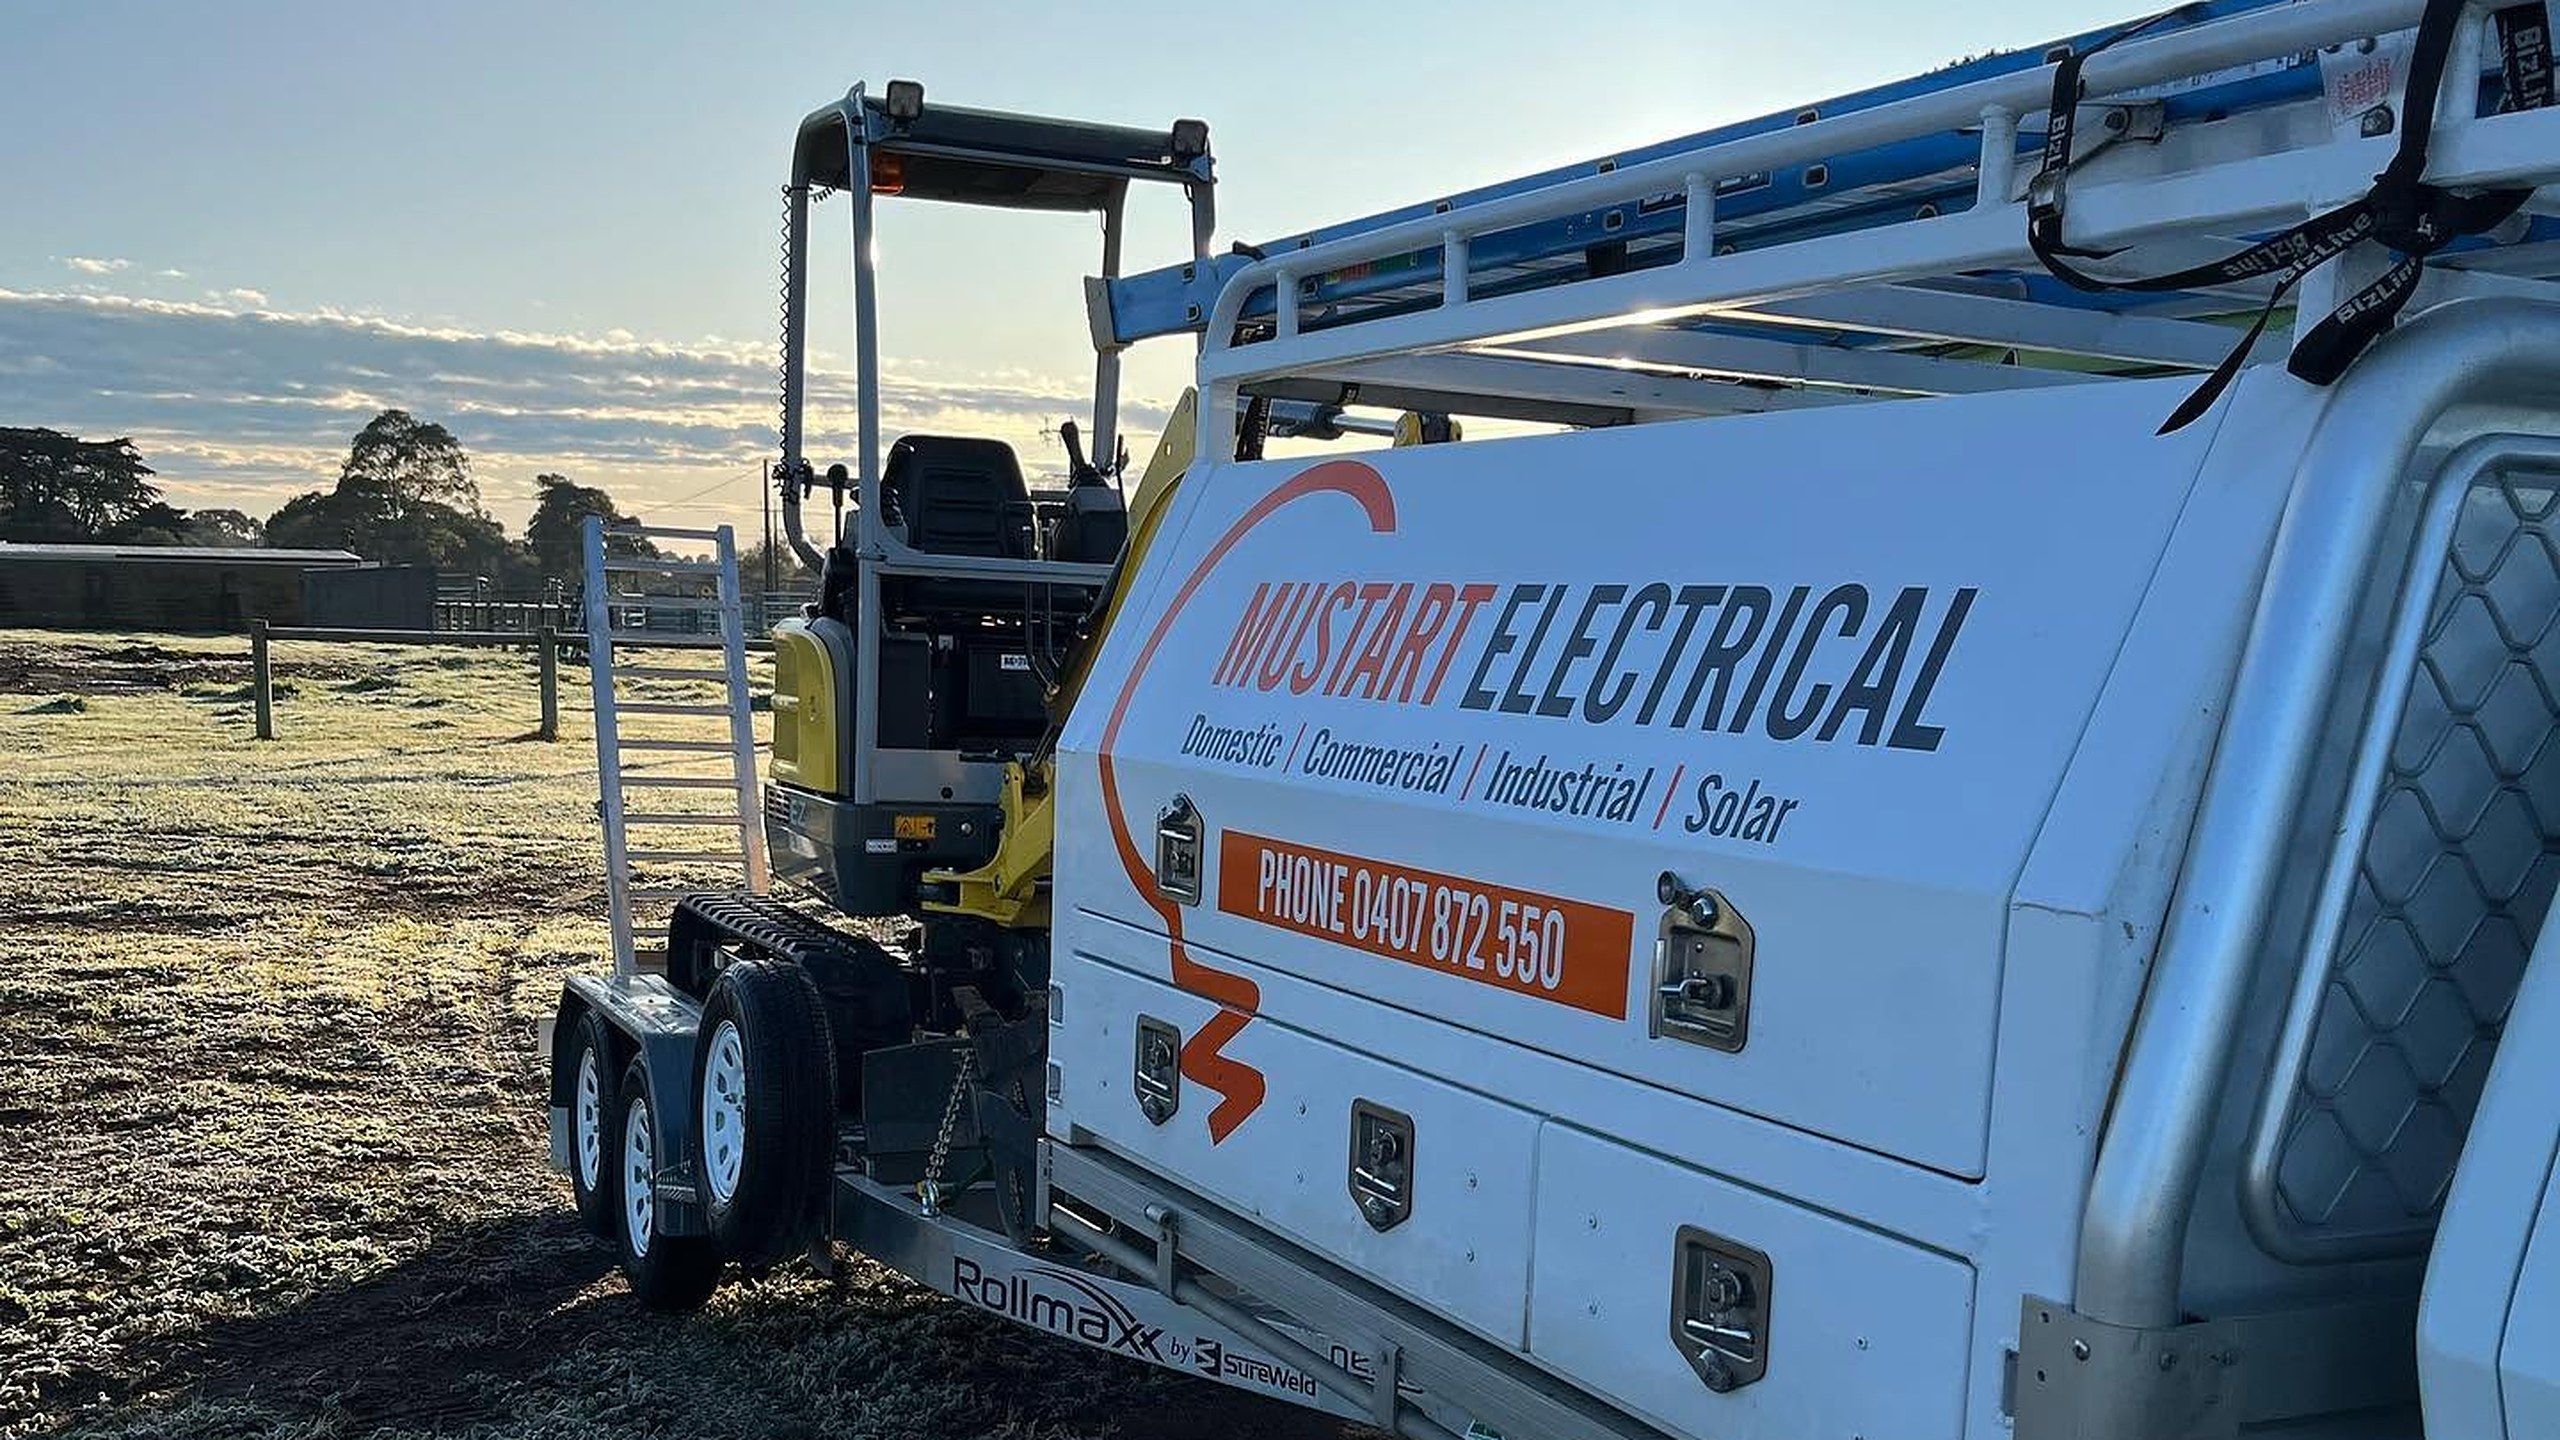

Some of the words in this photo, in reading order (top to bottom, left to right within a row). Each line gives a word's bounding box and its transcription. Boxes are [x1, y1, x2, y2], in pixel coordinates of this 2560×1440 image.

[1211, 580, 1498, 706] MUSTART
[1458, 581, 1978, 753] ELECTRICAL
[1181, 713, 1284, 769] Domestic
[1303, 718, 1464, 794] Commercial
[1484, 748, 1655, 823] Industrial
[1685, 773, 1799, 844] Solar
[1257, 848, 1348, 934] PHONE
[1352, 868, 1428, 953] 0407
[1430, 885, 1491, 971] 872
[1496, 900, 1566, 990] 550
[953, 1256, 1166, 1363] Rollmaxx
[1170, 1336, 1190, 1364] by
[1224, 1354, 1317, 1397] SureWeld
